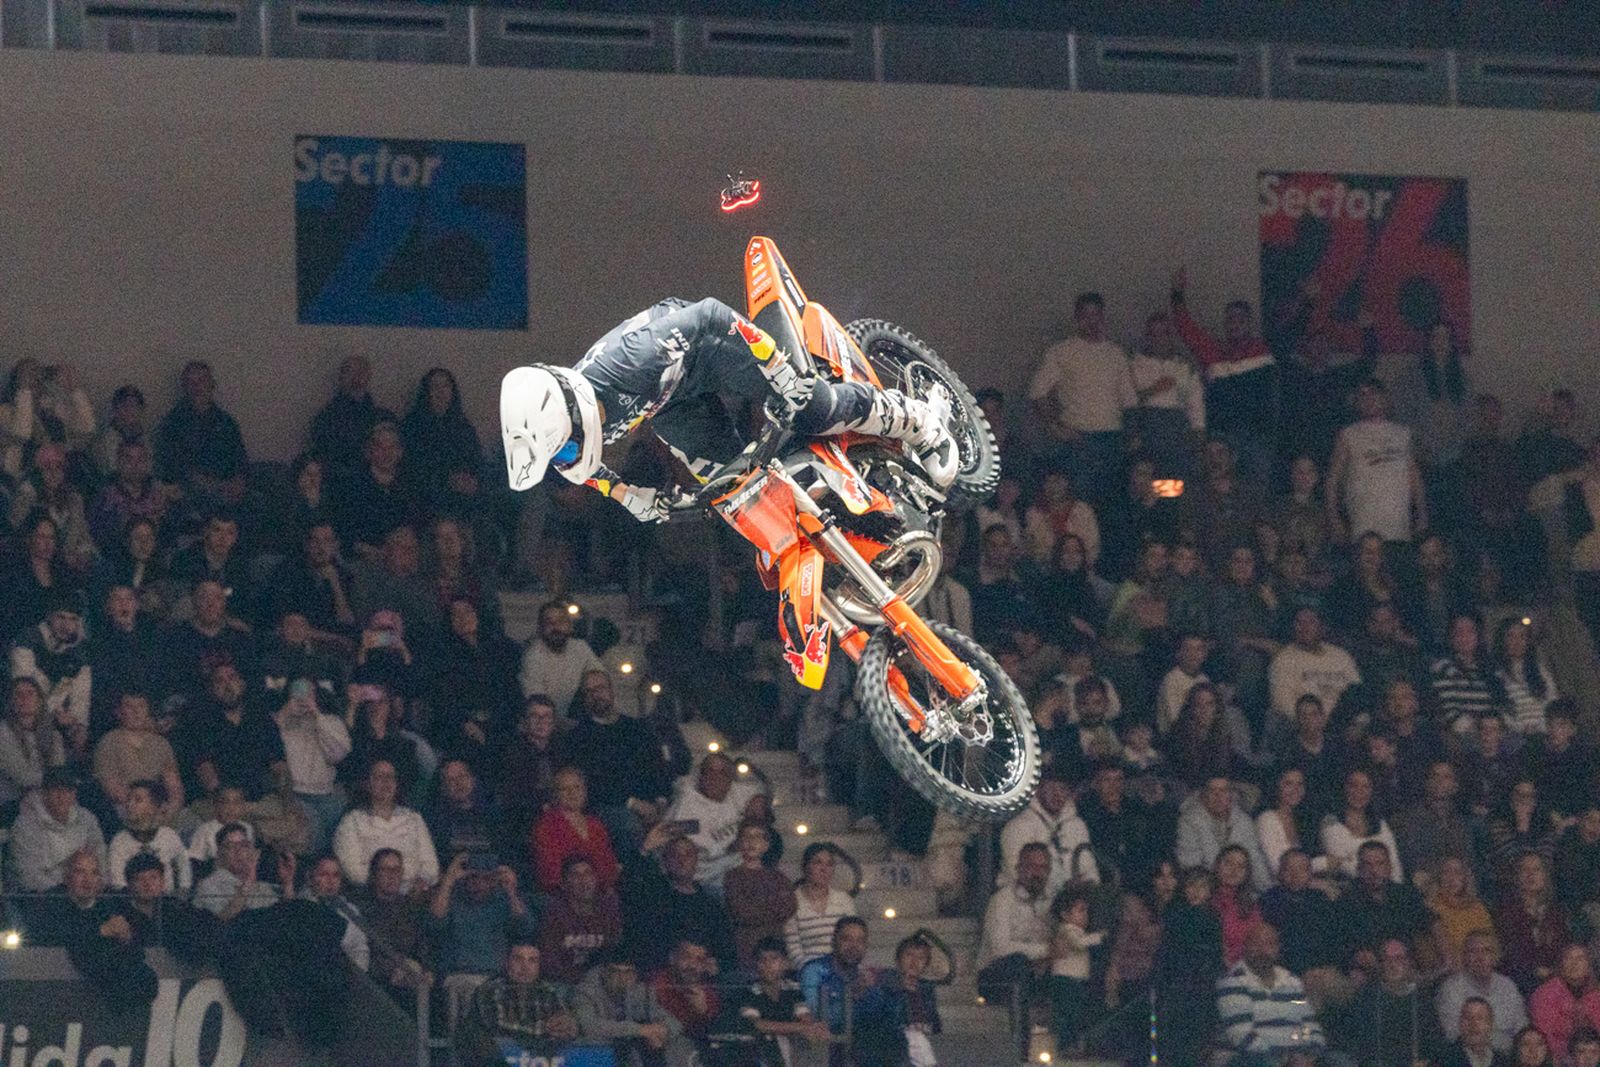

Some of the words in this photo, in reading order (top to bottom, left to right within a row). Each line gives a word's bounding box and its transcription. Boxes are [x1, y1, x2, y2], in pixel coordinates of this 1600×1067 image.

[294, 138, 442, 187] Sector
[1258, 174, 1392, 220] Sector
[144, 978, 247, 1067] 10
